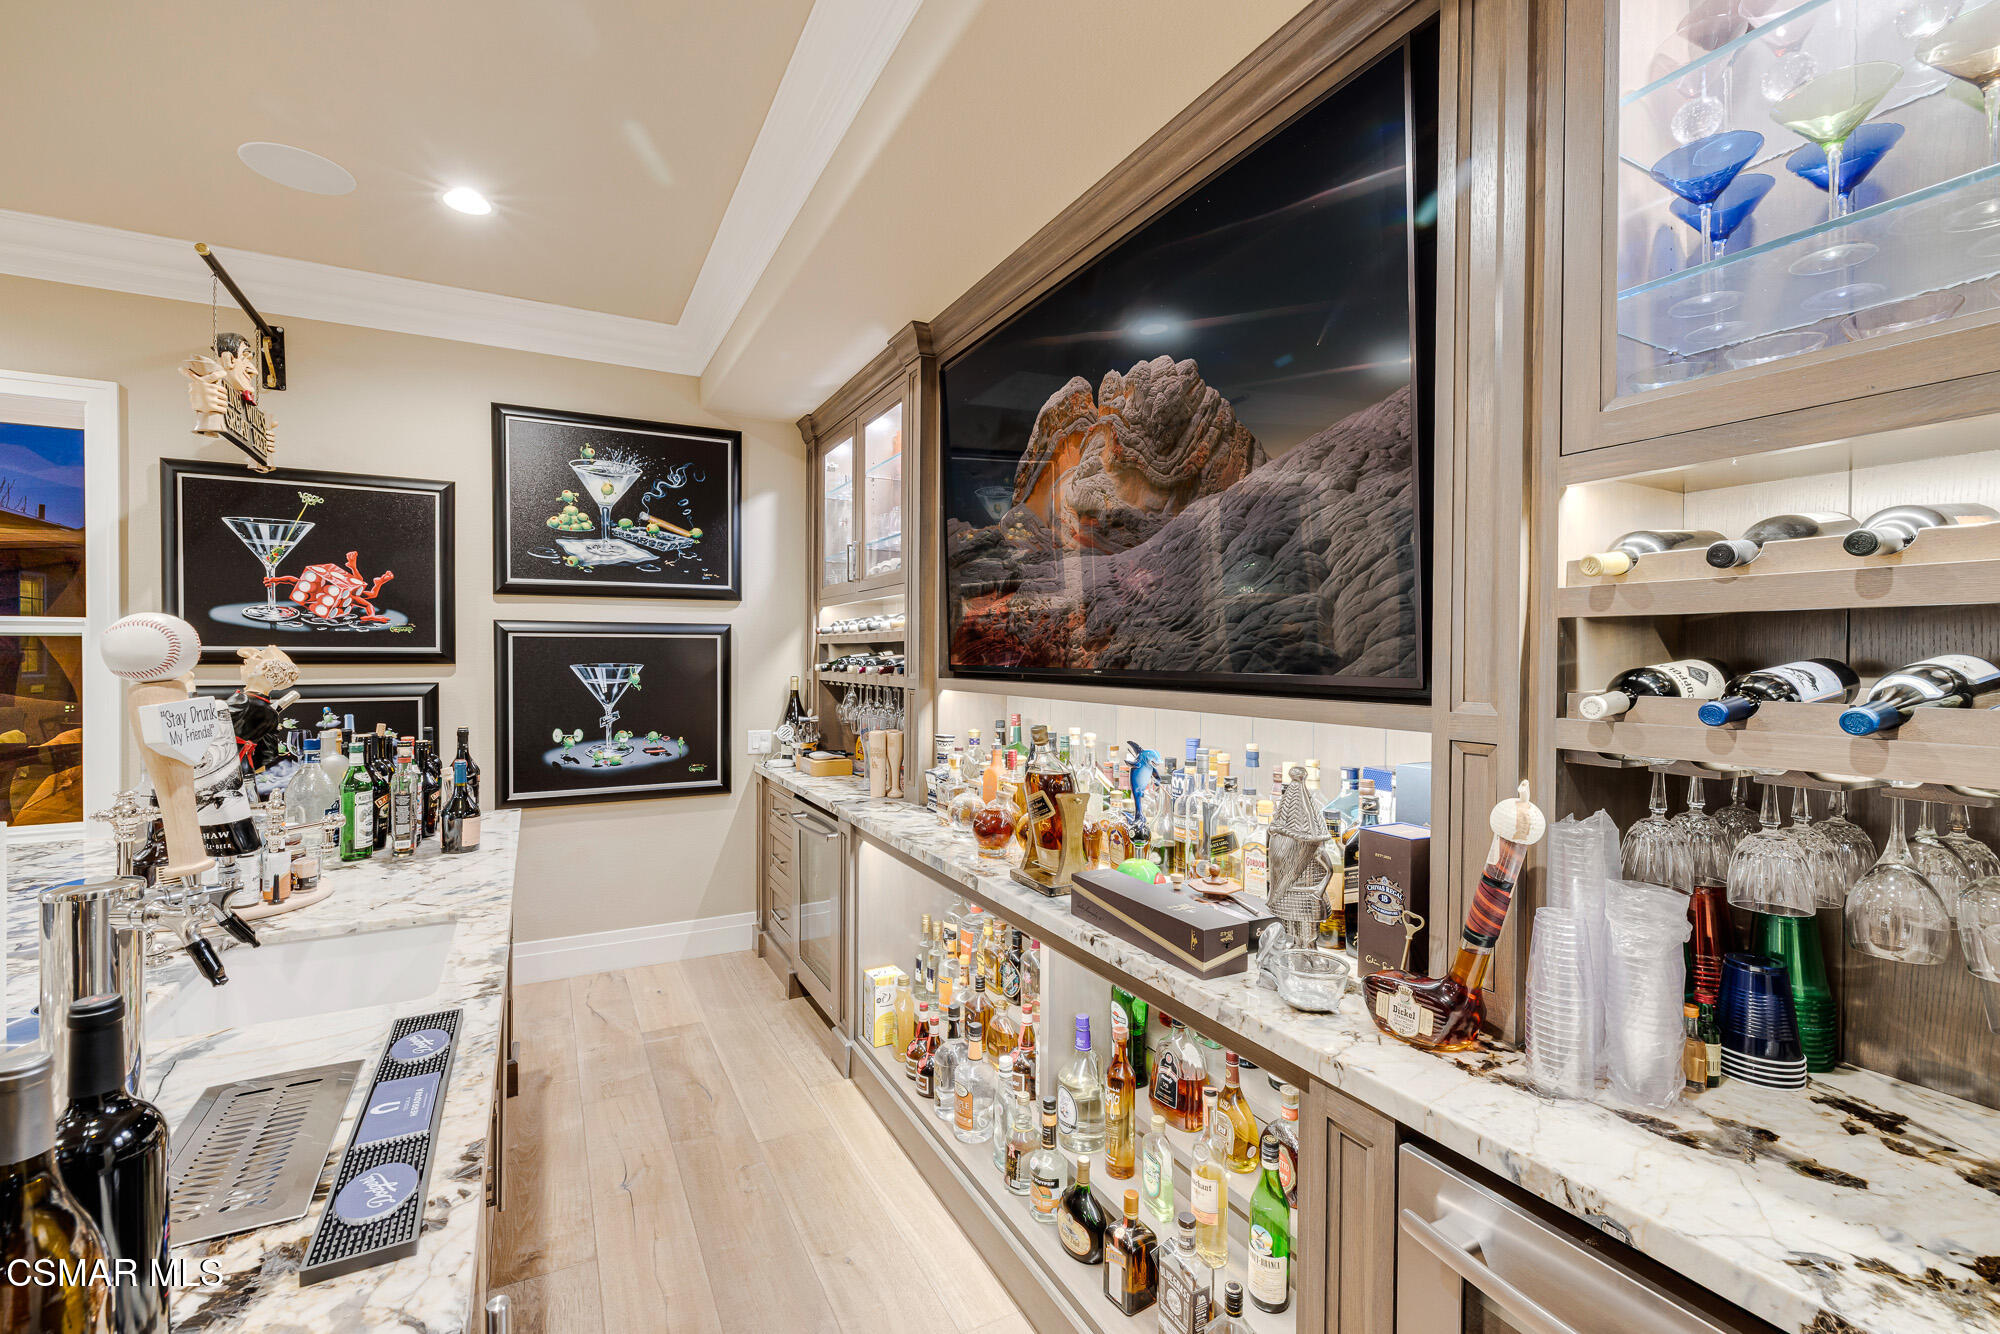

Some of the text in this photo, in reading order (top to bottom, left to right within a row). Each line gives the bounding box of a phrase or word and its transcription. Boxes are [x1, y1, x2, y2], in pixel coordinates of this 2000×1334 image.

[226, 407, 249, 440] GREAT
[189, 703, 218, 723] Drunk
[169, 730, 183, 746] My
[1380, 894, 1389, 903] 18
[1392, 1004, 1416, 1020] Dickel
